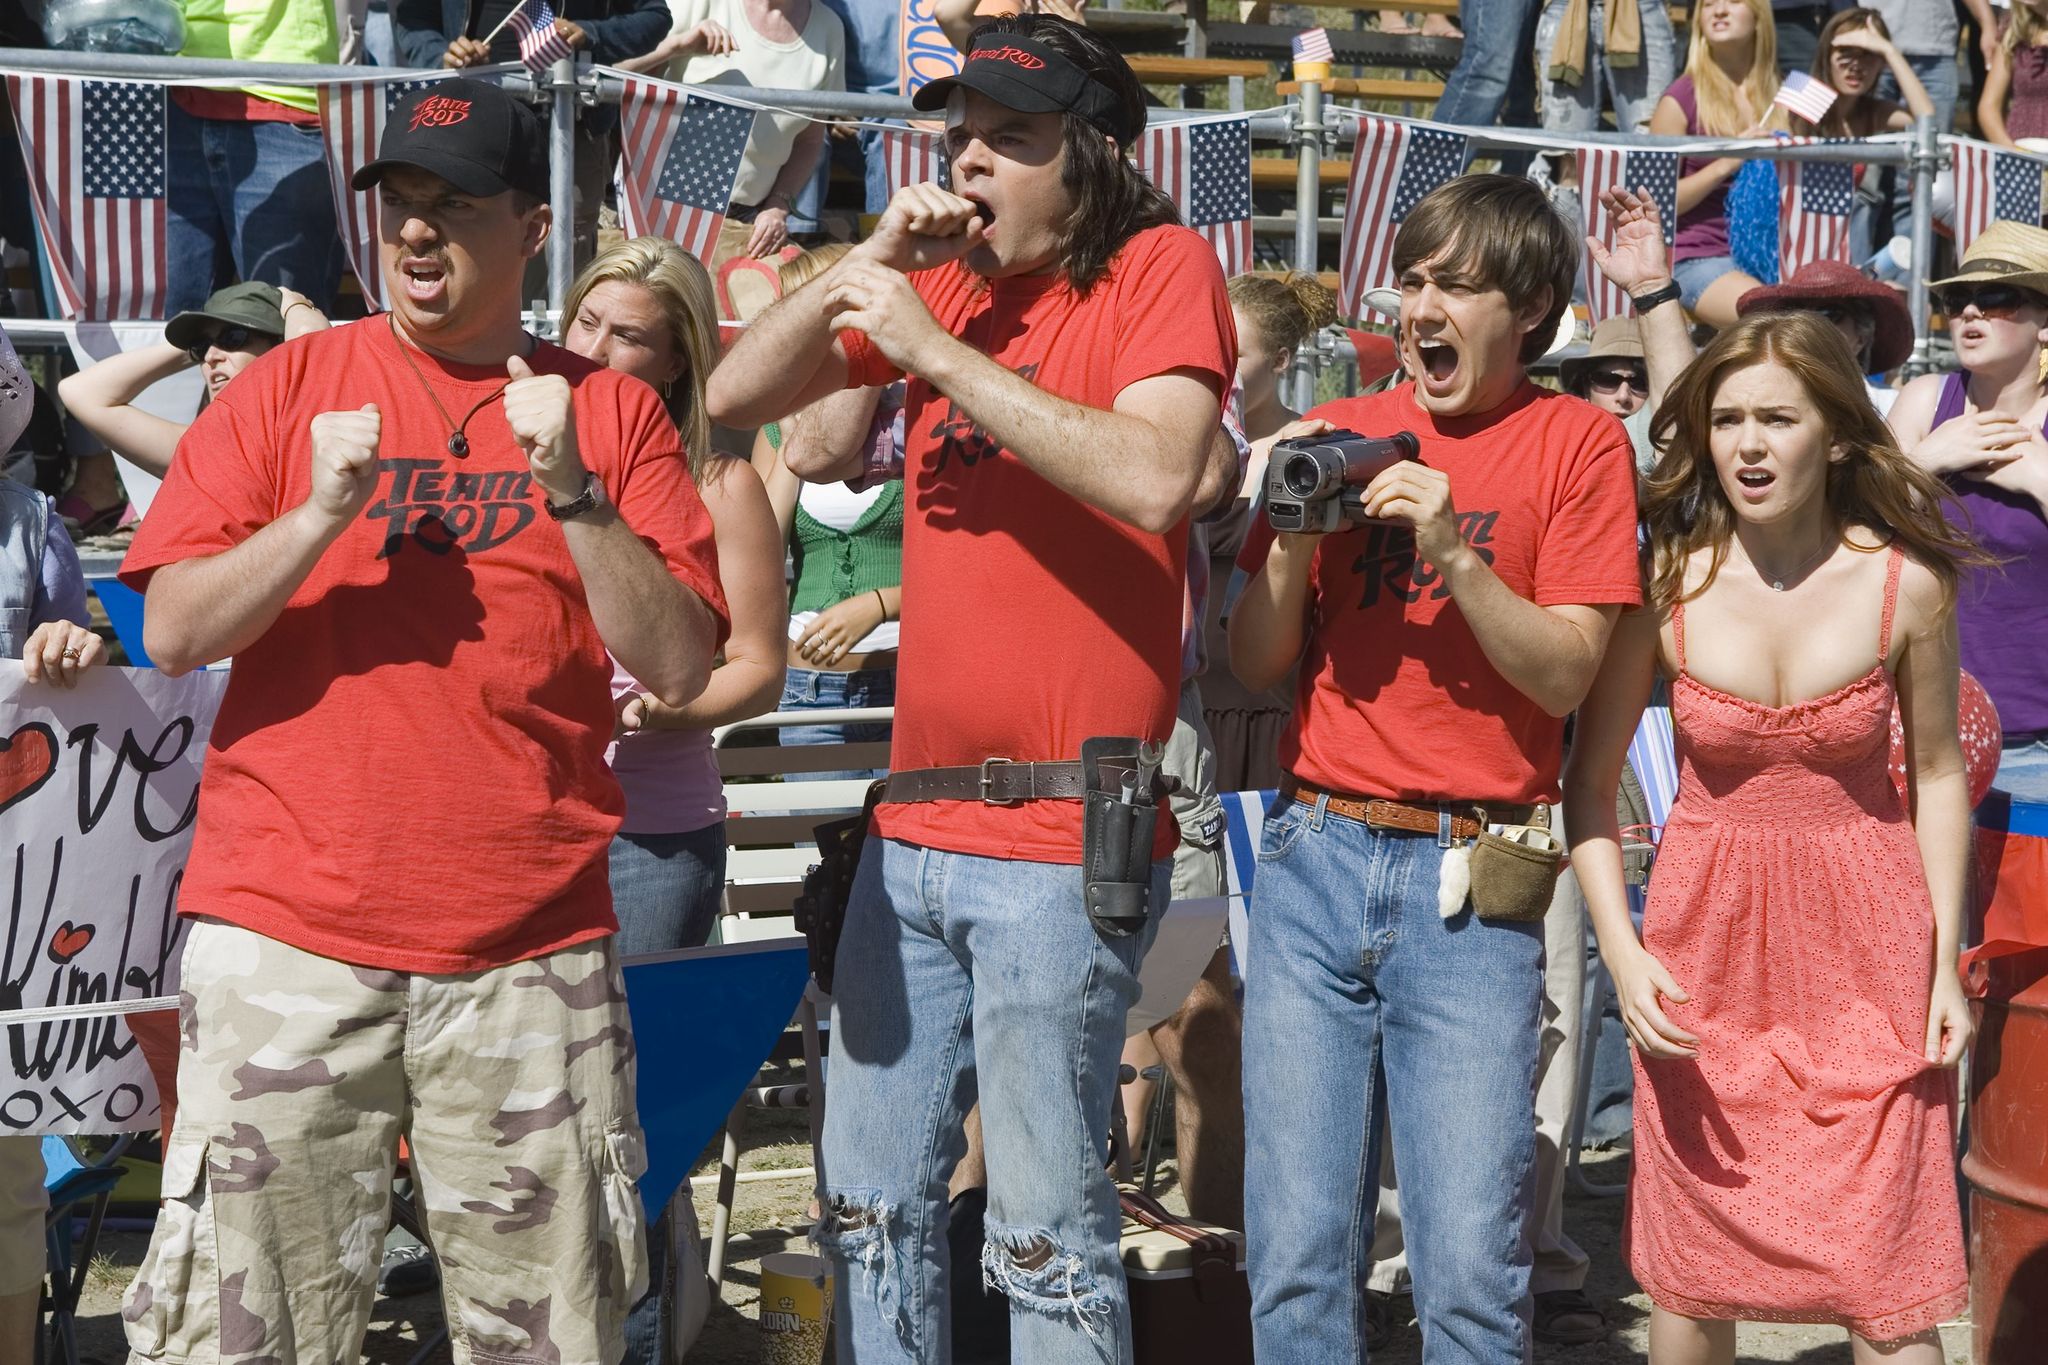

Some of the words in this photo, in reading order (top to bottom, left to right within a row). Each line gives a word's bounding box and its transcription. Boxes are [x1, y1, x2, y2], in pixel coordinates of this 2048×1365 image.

[997, 44, 1046, 70] ROD
[408, 110, 469, 133] ROD
[413, 95, 472, 113] TEAM
[376, 458, 533, 505] TEAM
[366, 499, 536, 561] ROD
[0, 1083, 161, 1129] OXO
